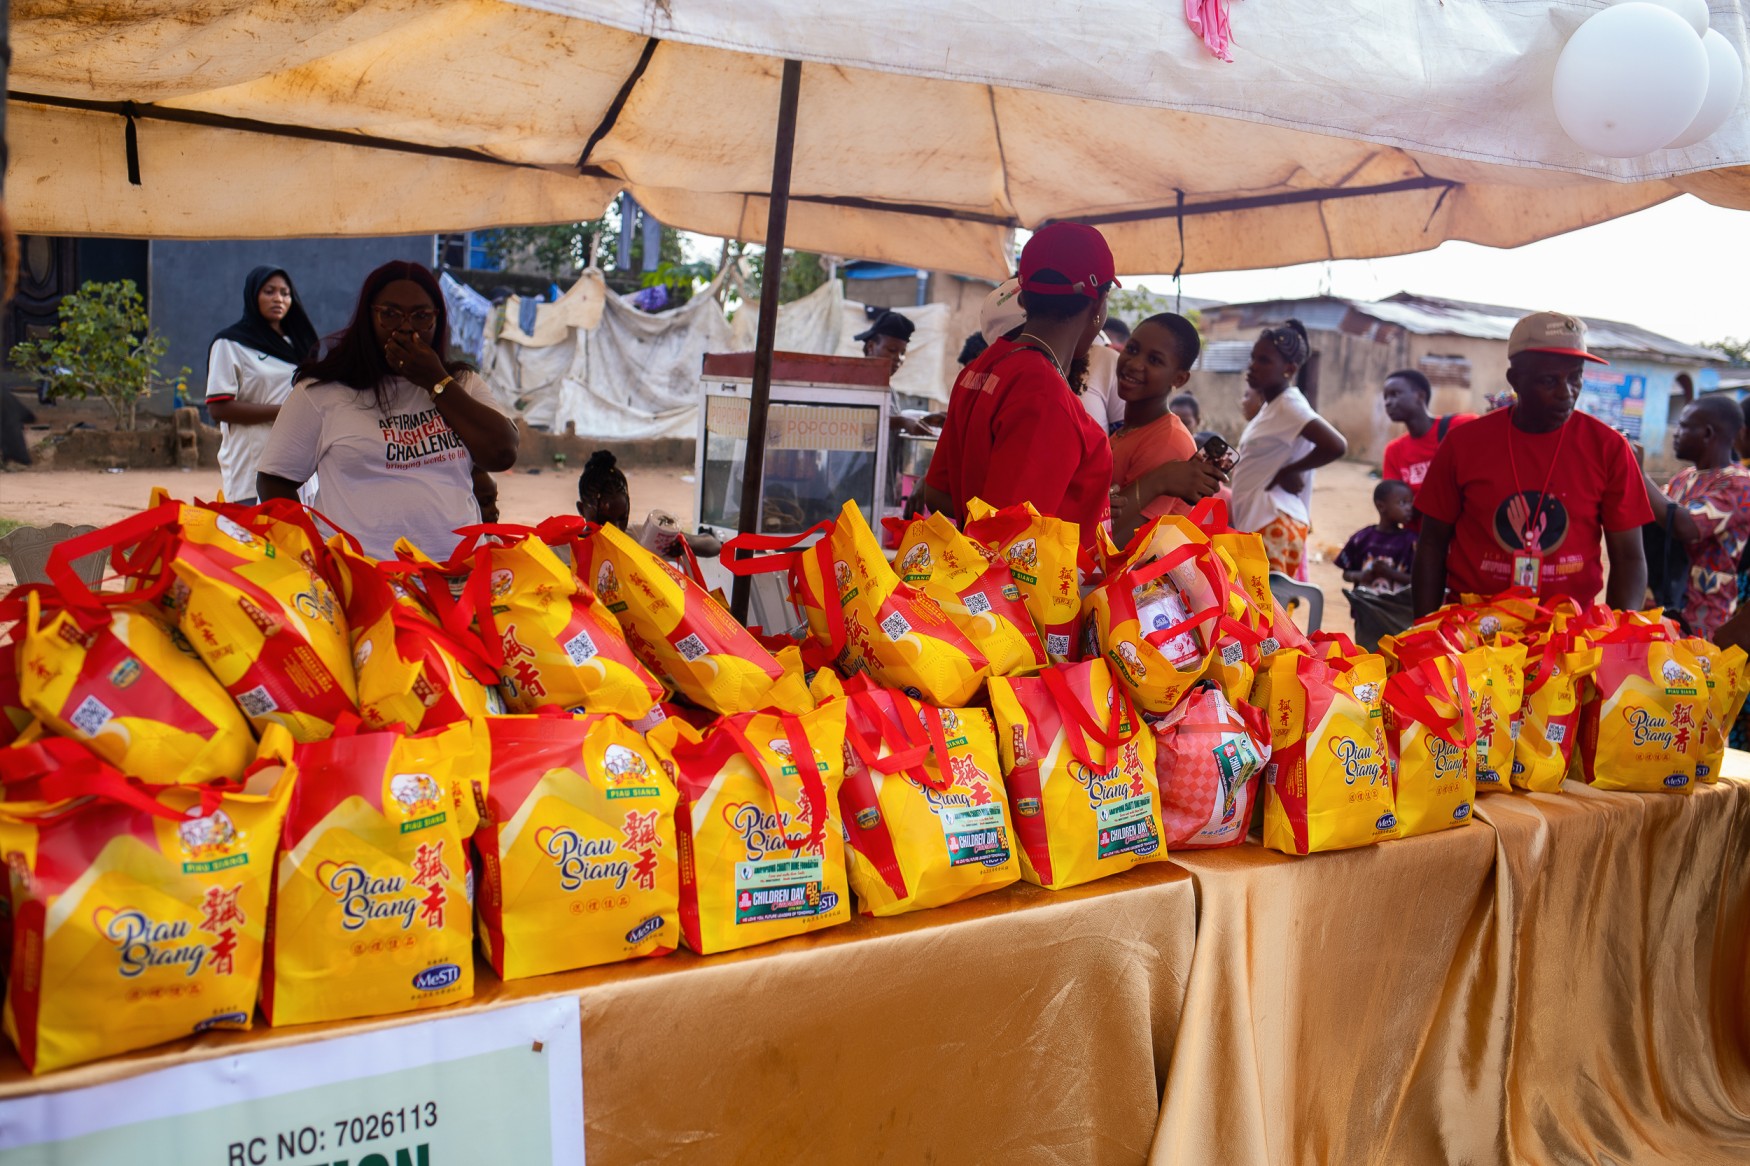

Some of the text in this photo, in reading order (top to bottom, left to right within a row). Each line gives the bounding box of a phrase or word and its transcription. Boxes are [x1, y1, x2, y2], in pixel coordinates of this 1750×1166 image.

[379, 407, 440, 430] AFFIRMATI
[787, 420, 859, 436] POPCORN
[382, 427, 422, 446] FLASH
[386, 460, 421, 470] bringing
[424, 453, 447, 465] words
[448, 451, 456, 461] to
[1017, 573, 1035, 584] SIANG
[1630, 710, 1667, 730] Piau
[1633, 726, 1673, 750] Siang
[1338, 740, 1372, 766] Piau
[1345, 760, 1380, 786] Siang
[1434, 755, 1463, 779] Siang
[609, 788, 657, 798] PIAU SIANG
[926, 787, 971, 814] Siang
[1089, 782, 1129, 810] Siang
[403, 815, 445, 832] PIAU SIANG
[1110, 824, 1137, 842] CHILDREN
[1136, 821, 1148, 833] DAY
[548, 831, 615, 866] Piau
[622, 811, 662, 890] 飄香
[959, 833, 986, 849] CHILDREN
[986, 831, 998, 844] DAY
[330, 867, 405, 903] Piau
[560, 857, 632, 891] Siang
[753, 890, 789, 906] CHILDREN
[790, 886, 805, 901] DAY
[806, 881, 818, 895] 20
[342, 894, 417, 931] Siang
[107, 912, 190, 951] Piau
[628, 918, 660, 944] MeSTI
[118, 943, 206, 978] Siang
[416, 965, 458, 989] MeSTI
[228, 1101, 438, 1166] RC NO: 7026113
